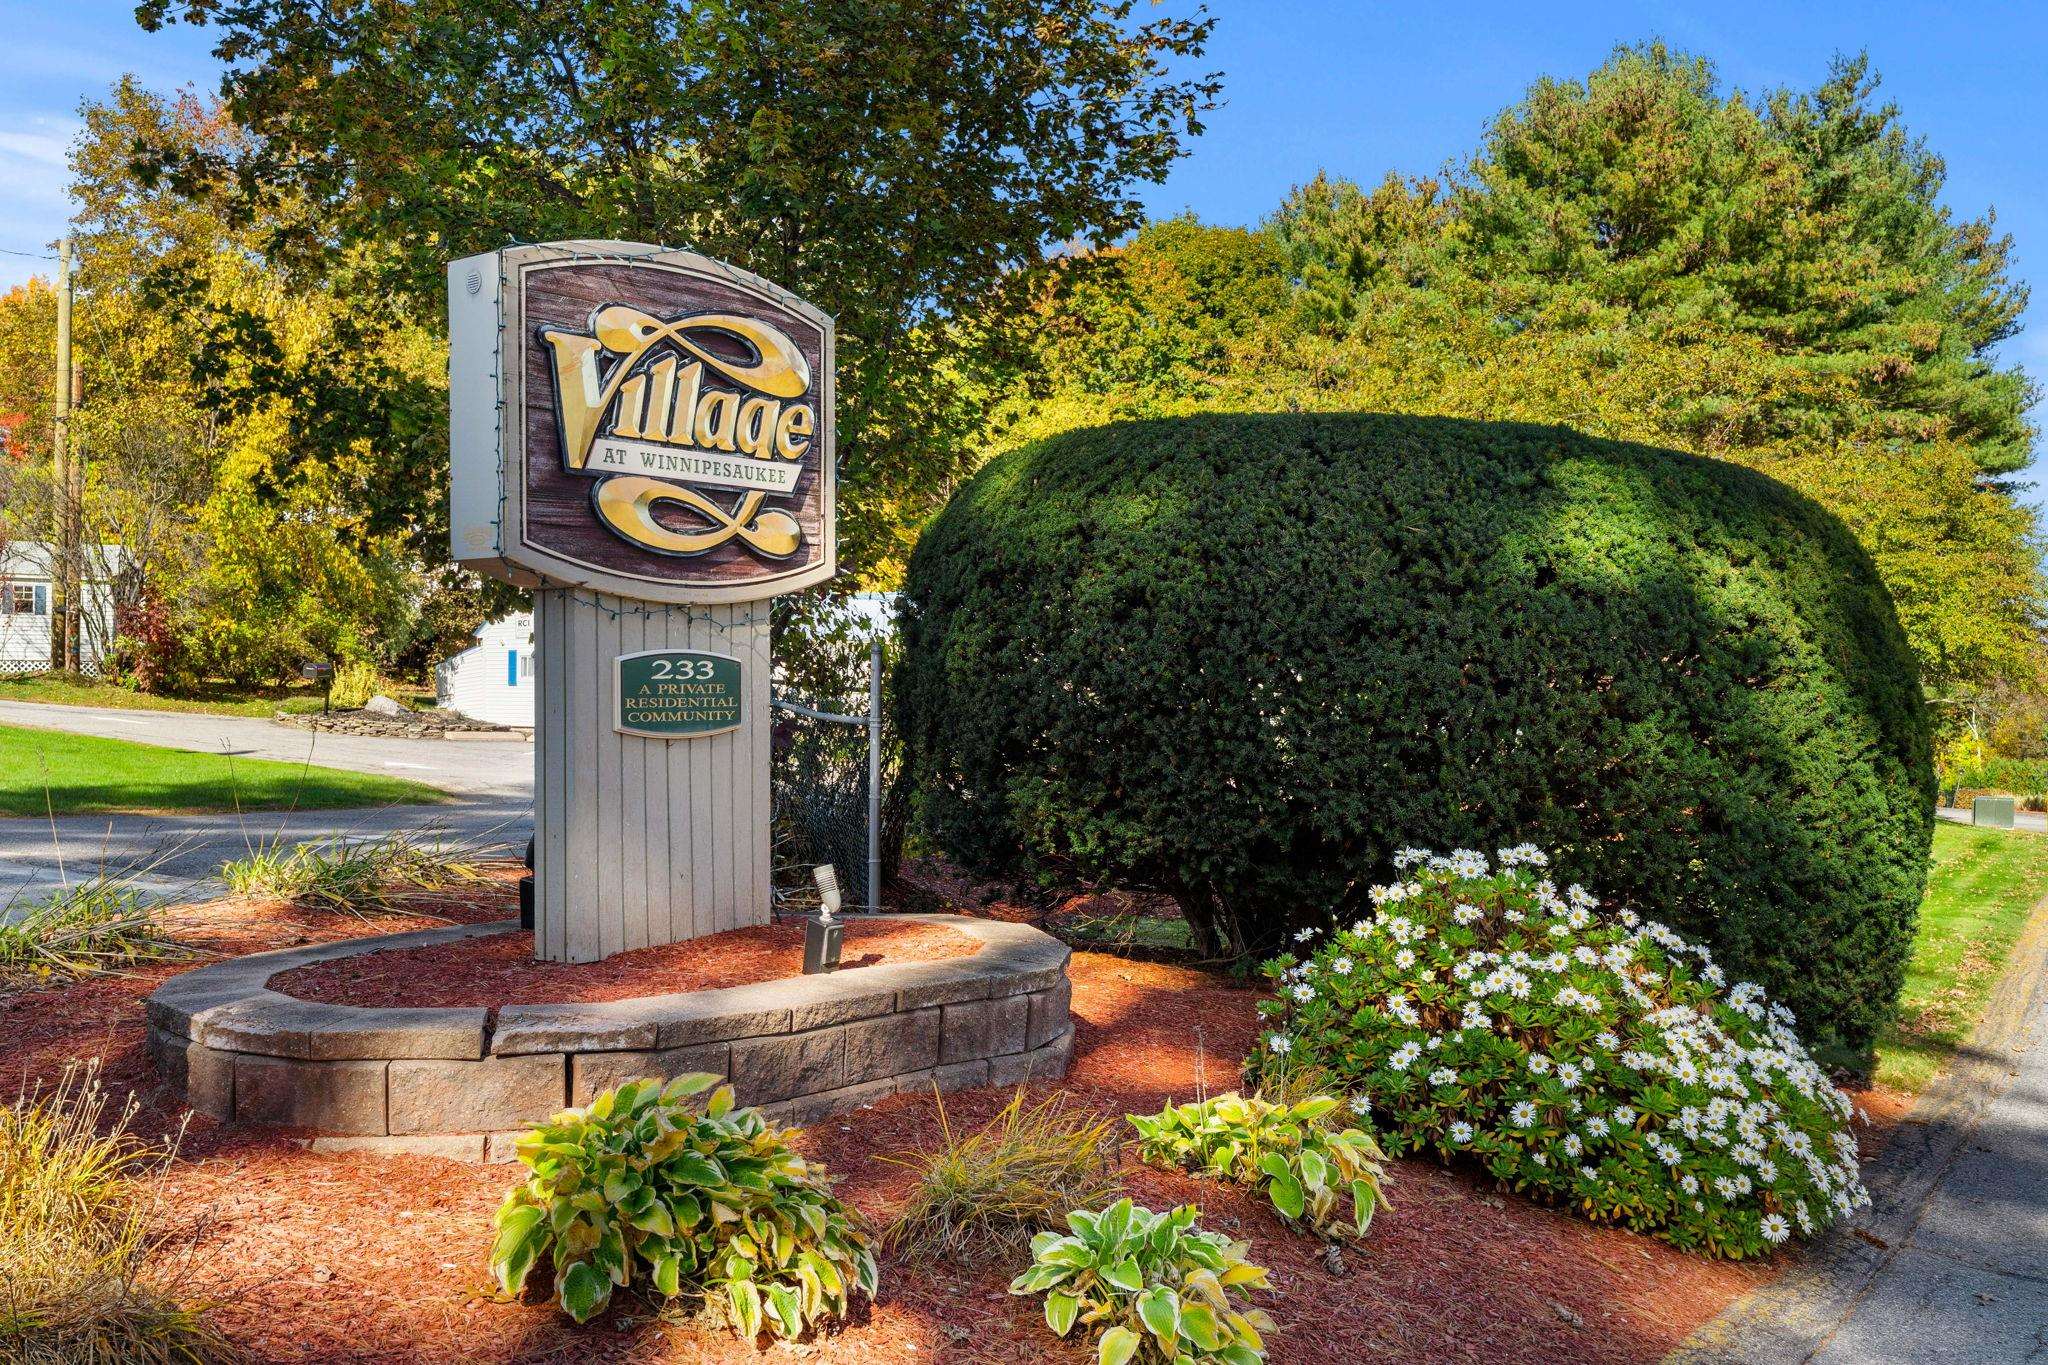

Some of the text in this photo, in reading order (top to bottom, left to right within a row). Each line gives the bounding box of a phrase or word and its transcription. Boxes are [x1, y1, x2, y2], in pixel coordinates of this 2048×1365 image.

[541, 305, 815, 470] Village
[602, 447, 787, 485] AT WINNIPESAUKEE
[651, 659, 715, 680] 233
[638, 683, 726, 695] A PRIVATE
[624, 696, 738, 709] RESIDENTIAL
[627, 710, 736, 723] COMMUNITY
